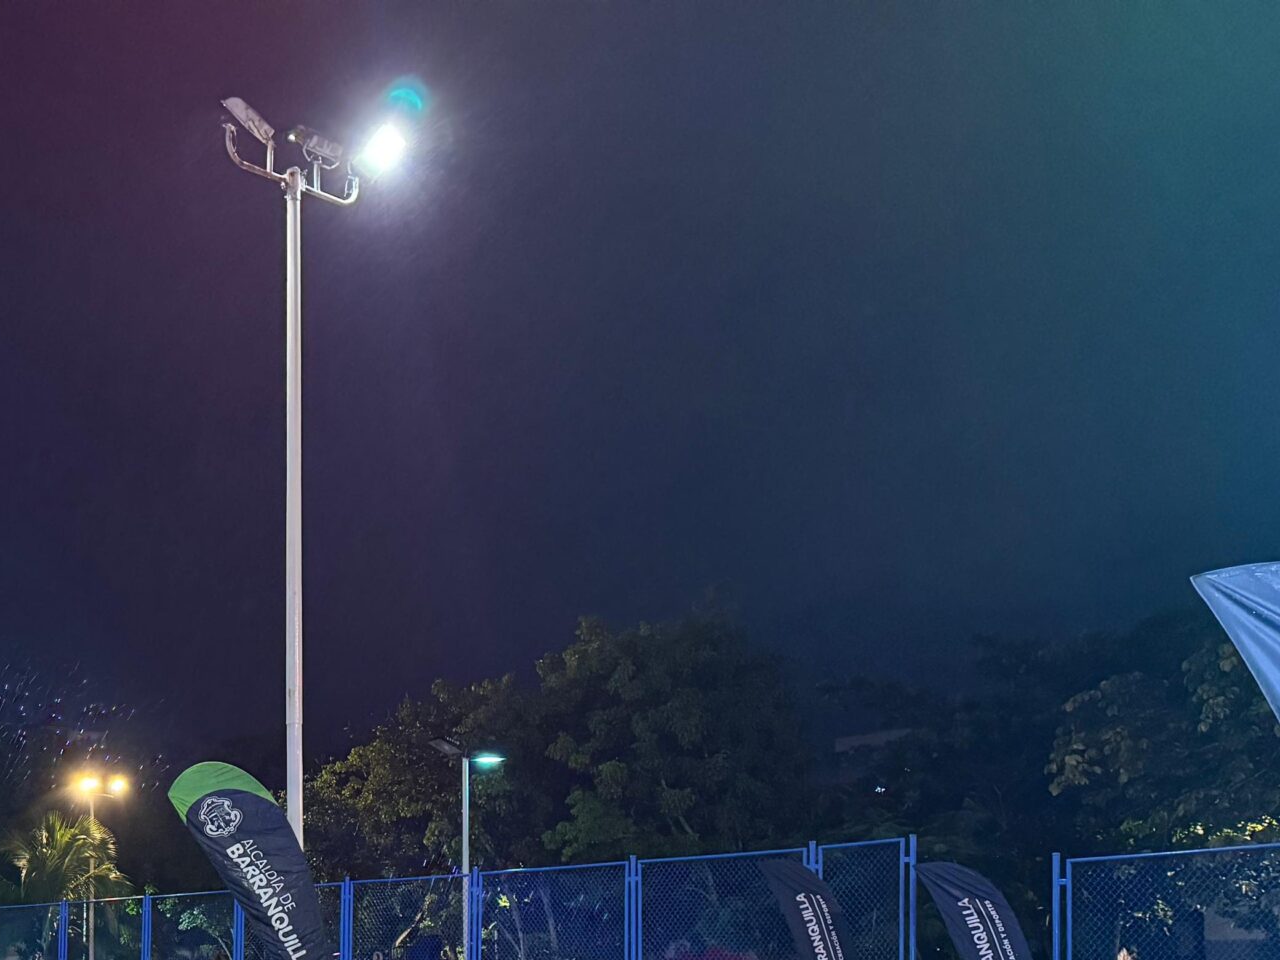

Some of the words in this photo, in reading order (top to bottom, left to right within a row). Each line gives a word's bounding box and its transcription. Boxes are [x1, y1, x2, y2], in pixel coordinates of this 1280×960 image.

[241, 839, 285, 893] ALCALDÍA
[279, 893, 297, 912] DE
[984, 900, 1005, 932] DEPORTES
